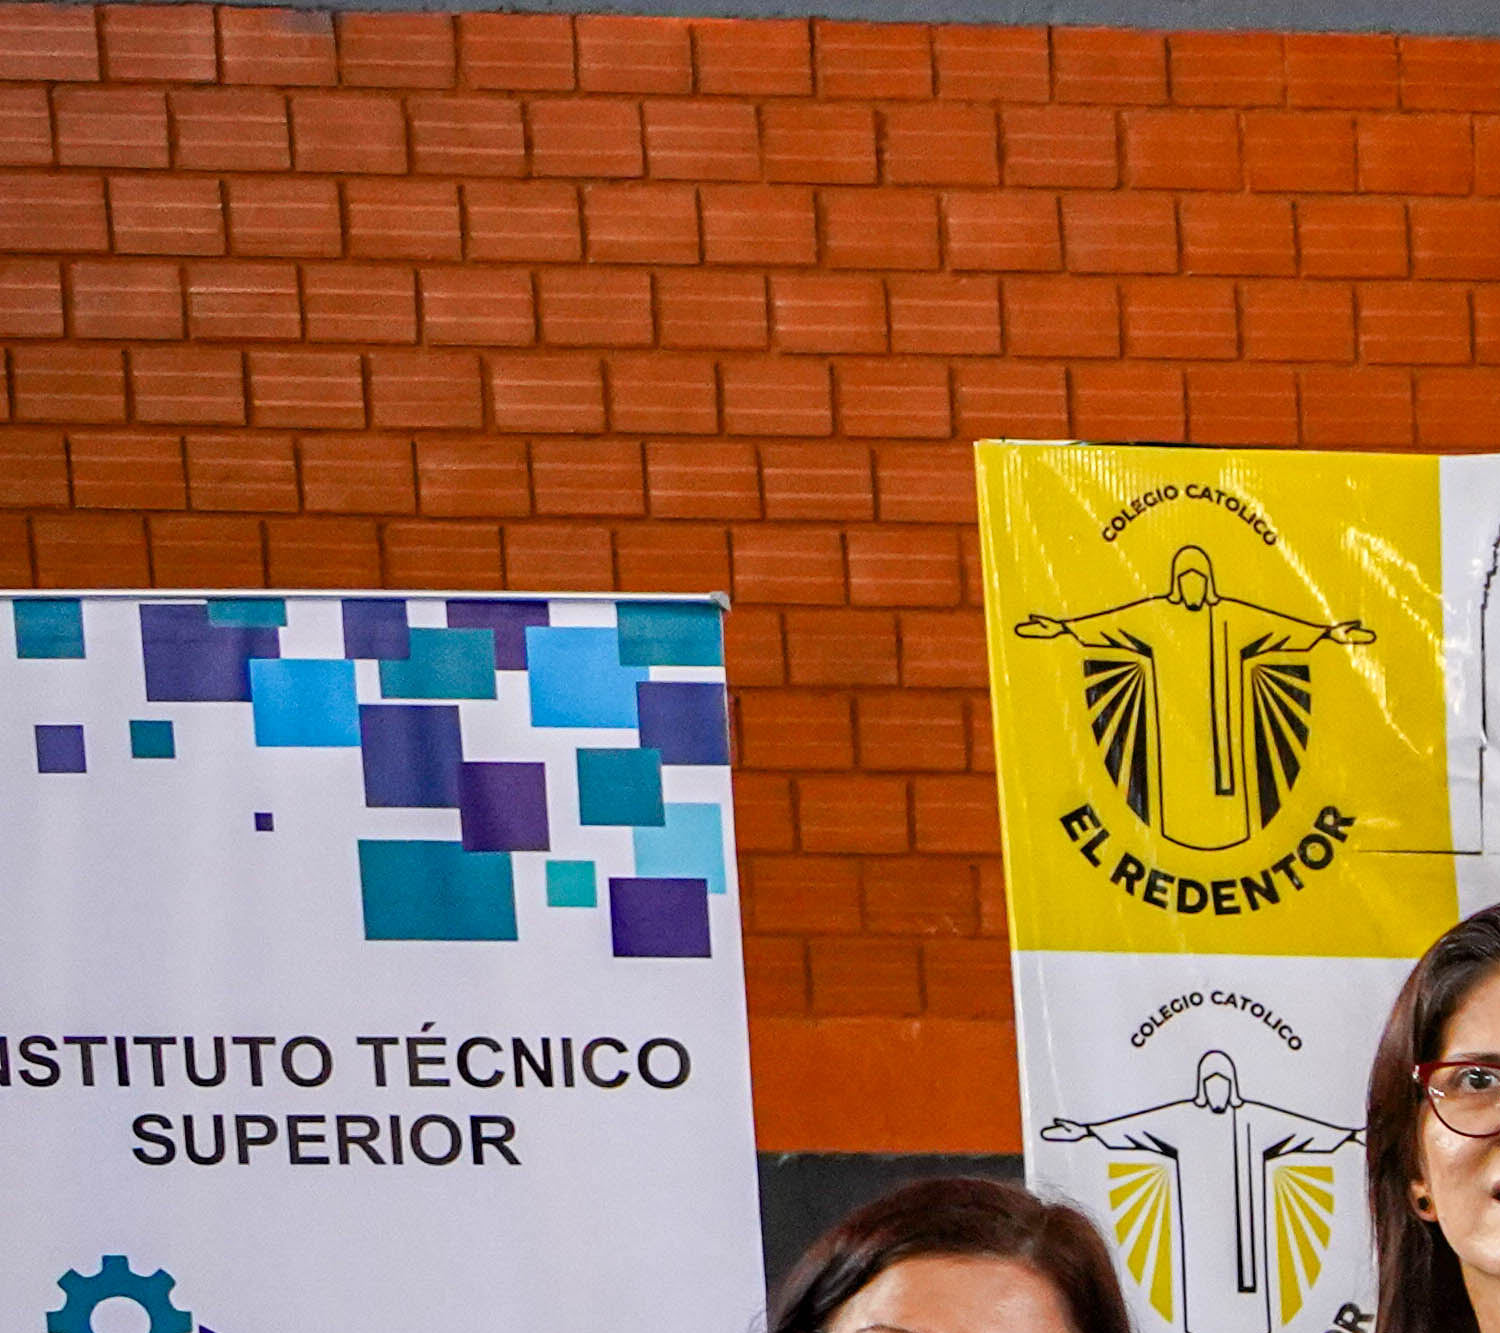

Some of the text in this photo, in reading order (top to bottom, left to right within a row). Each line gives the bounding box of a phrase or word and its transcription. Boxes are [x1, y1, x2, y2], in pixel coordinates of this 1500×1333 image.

[1102, 484, 1276, 546] COLEGIO CATOLICO
[1059, 803, 1356, 916] EL REDENTOR
[1130, 990, 1303, 1051] COLEGIO CATOLICO
[356, 1021, 691, 1090] TÉCNICO
[132, 1113, 522, 1166] SUPERIOR
